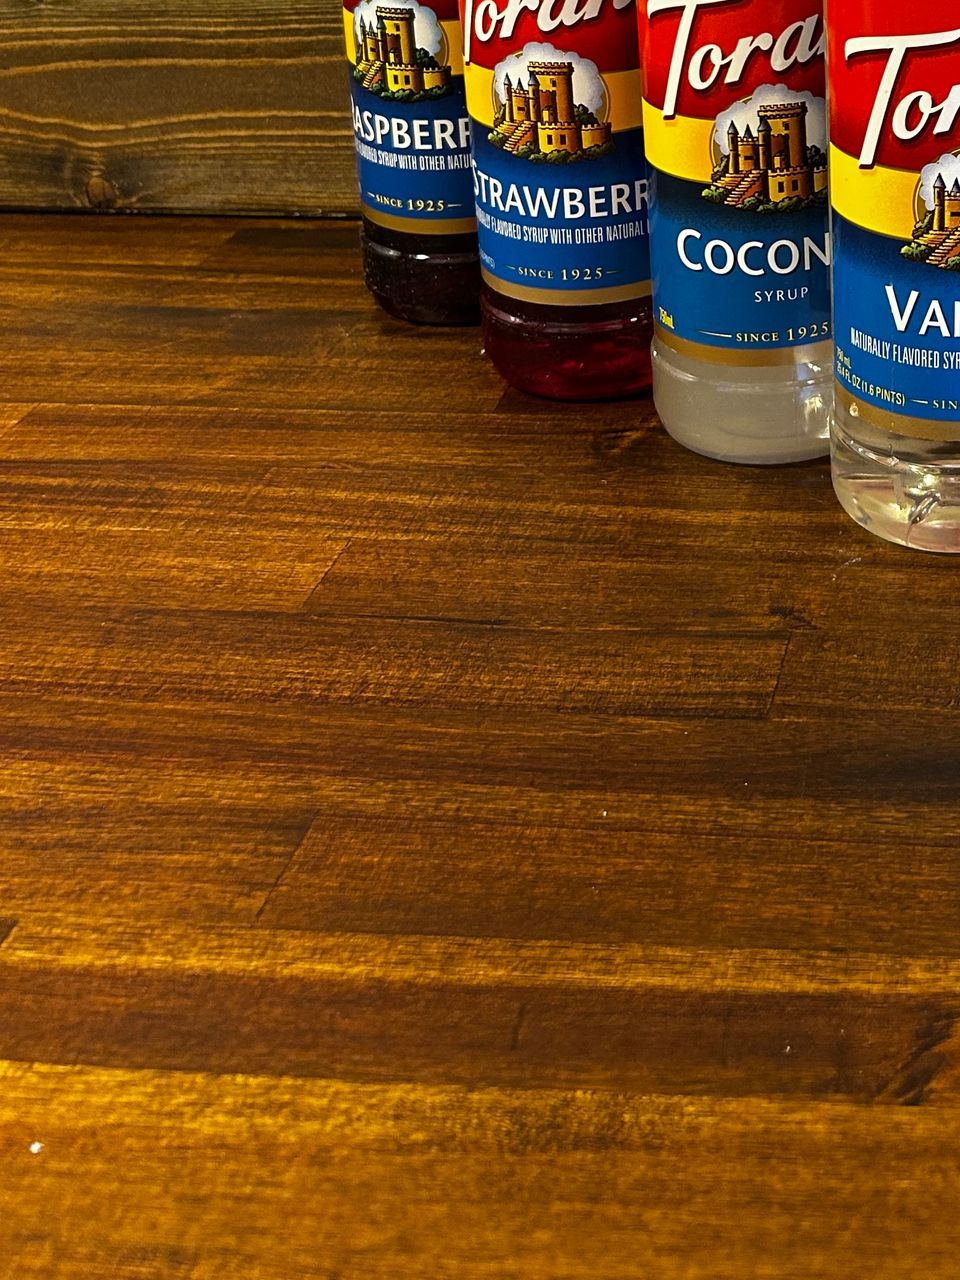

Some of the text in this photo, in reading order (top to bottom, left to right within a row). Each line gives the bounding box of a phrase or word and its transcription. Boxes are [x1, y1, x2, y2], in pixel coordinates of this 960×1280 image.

[378, 150, 397, 168] SYRUP
[398, 154, 417, 170] WITH
[420, 155, 445, 171] OTHER
[448, 154, 472, 169] NATU
[375, 194, 444, 212] SINCE 1925
[491, 215, 522, 240] FLAVORED
[523, 226, 548, 243] SYRUP
[550, 228, 573, 244] WITH
[575, 226, 604, 244] OTHER
[606, 221, 645, 242] NATURAL
[518, 266, 603, 280] SINCE 1925
[754, 286, 809, 303] SYRUP
[735, 321, 829, 342] SINCE 1925
[850, 326, 890, 360] NATURALLY
[892, 343, 940, 369] FLAVORED
[852, 374, 861, 390] OZ
[861, 380, 875, 397] (1.6
[875, 386, 906, 407] PINTS)
